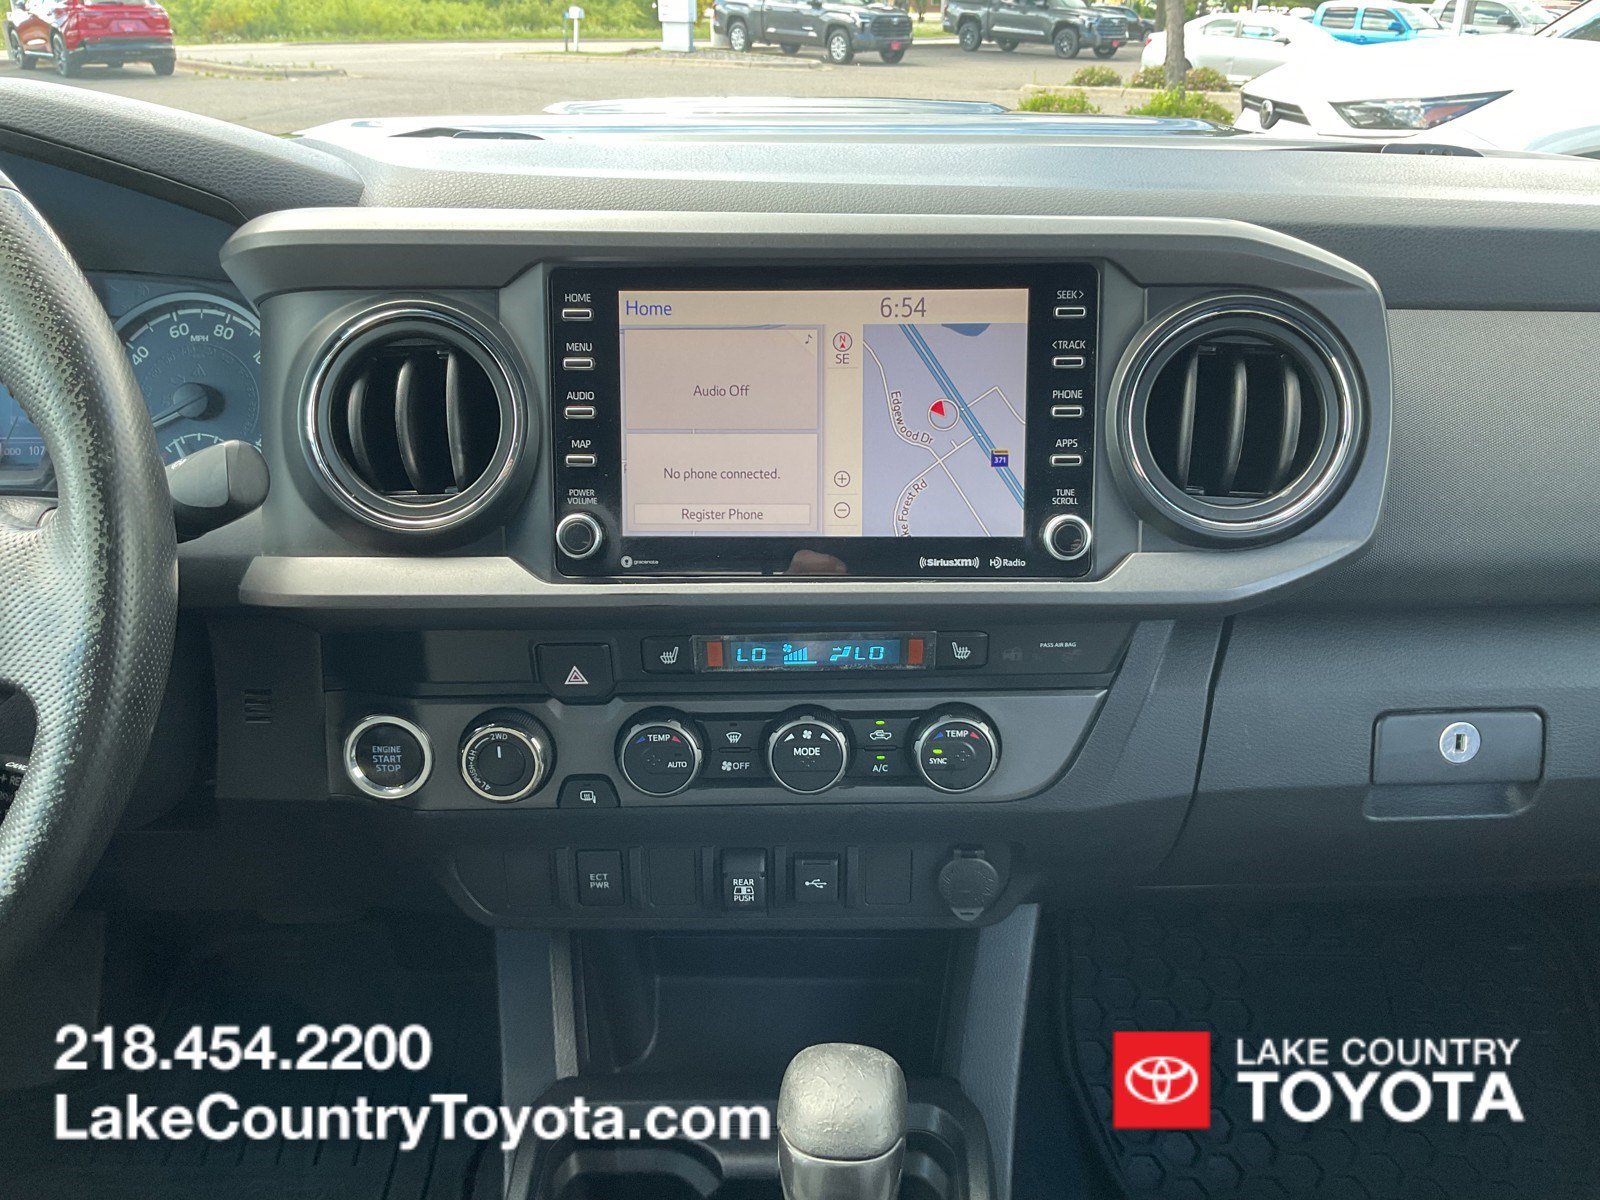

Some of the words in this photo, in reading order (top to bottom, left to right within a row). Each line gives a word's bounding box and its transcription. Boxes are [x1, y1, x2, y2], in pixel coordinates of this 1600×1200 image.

[564, 293, 591, 303] HOME
[625, 300, 672, 316] Home
[880, 296, 927, 318] 6:54
[168, 322, 190, 339] 60
[213, 323, 235, 340] 80
[190, 334, 209, 342] MPH
[839, 335, 846, 343] N
[566, 342, 592, 352] MENU
[131, 346, 149, 366] 40
[835, 353, 850, 365] SE
[693, 384, 726, 397] Audio
[729, 384, 750, 397] Off
[1052, 389, 1083, 400] PHONE
[566, 391, 595, 401] AUDIO
[890, 390, 920, 441] Edgewood
[920, 432, 933, 444] Dr
[571, 439, 591, 449] MAP
[1055, 438, 1078, 449] APPS
[993, 456, 1007, 465] 371
[663, 467, 681, 480] No
[683, 467, 717, 482] phone
[720, 467, 781, 480] connected.
[568, 488, 595, 497] POWER
[1056, 488, 1075, 497] TUNE
[567, 497, 597, 505] VOLUME
[898, 491, 916, 523] Forest
[911, 479, 928, 494] Rd
[1051, 497, 1079, 506] SCROLL
[681, 508, 726, 523] Register
[728, 508, 764, 521] Phone
[1003, 558, 1026, 567] Radio
[736, 647, 767, 662] LO
[854, 645, 885, 661] LO
[489, 733, 508, 741] 2WD
[647, 734, 671, 742] TEMP
[945, 729, 969, 738] TEMP
[372, 745, 401, 754] ENGINE
[793, 747, 821, 757] MODE
[372, 754, 402, 764] START
[928, 757, 948, 765] SYNC
[375, 764, 402, 773] STOP
[732, 761, 750, 770] OFF
[872, 764, 889, 773] A/C
[589, 873, 609, 881] ECT
[589, 881, 610, 889] PWR
[732, 878, 755, 887] REAR
[733, 894, 755, 902] PUSH
